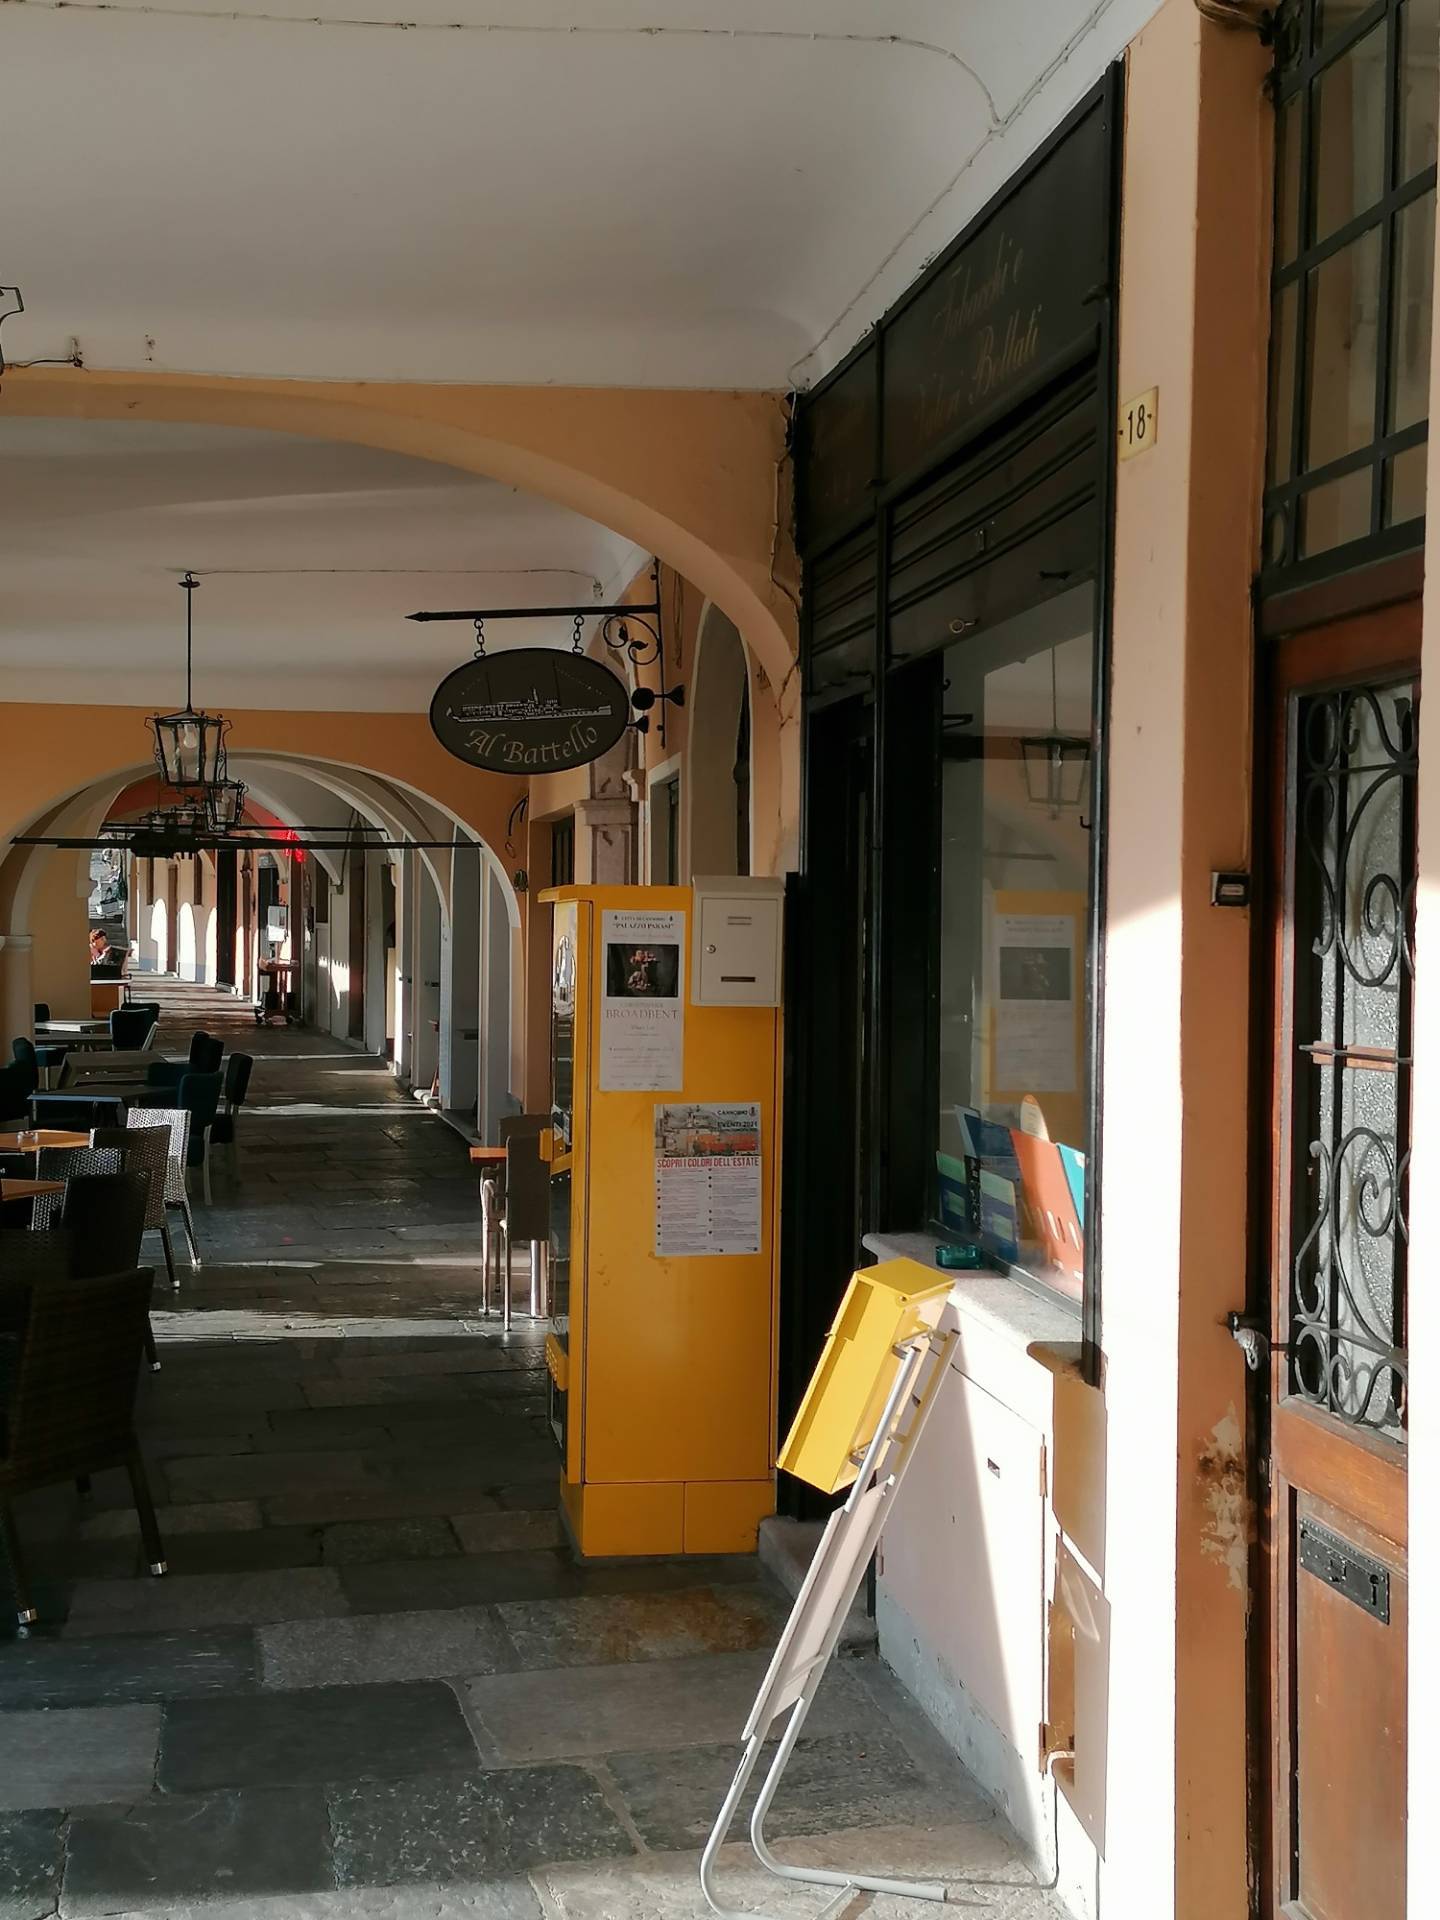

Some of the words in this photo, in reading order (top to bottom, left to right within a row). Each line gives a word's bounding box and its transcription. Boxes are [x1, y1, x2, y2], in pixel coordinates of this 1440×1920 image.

[1127, 403, 1146, 445] 18
[464, 729, 506, 757] Al
[502, 719, 599, 765] Battello
[606, 1008, 680, 1019] BROADBENT
[656, 1157, 683, 1168] SCOPRI
[687, 1157, 713, 1168] COLORI
[713, 1156, 759, 1168] DELL'ESTATE
